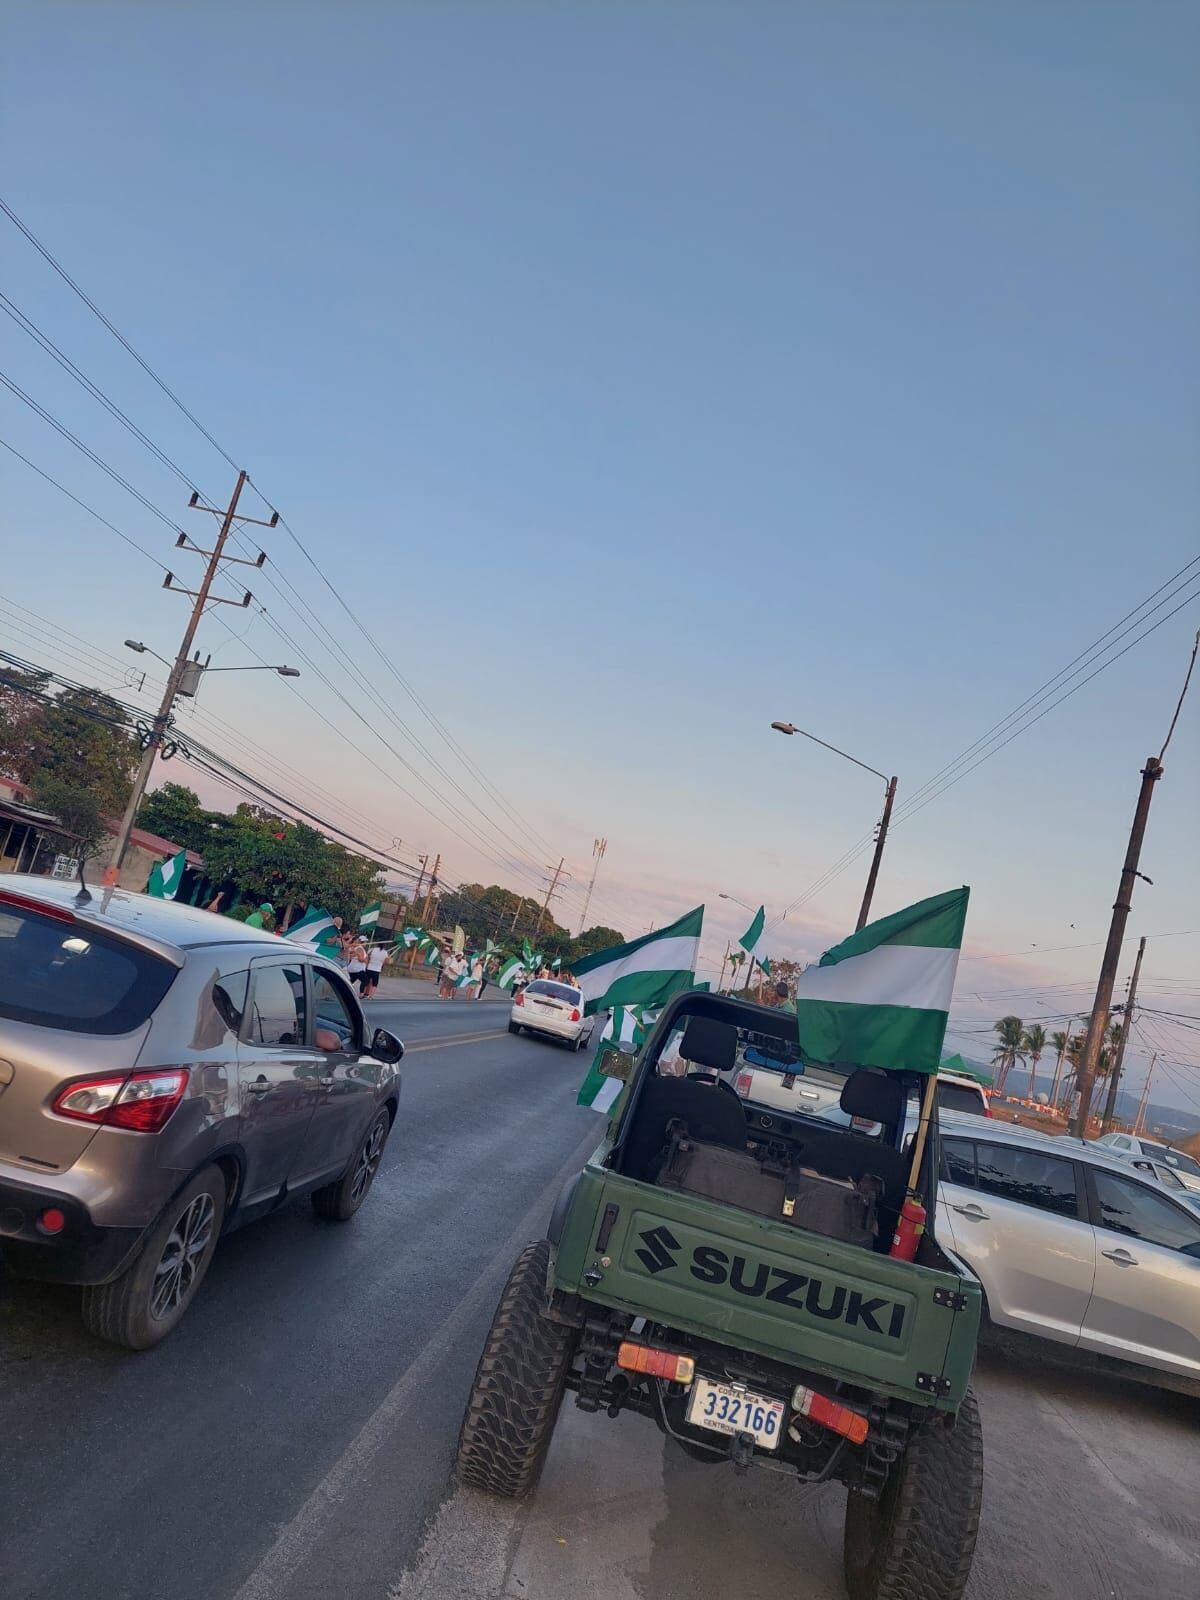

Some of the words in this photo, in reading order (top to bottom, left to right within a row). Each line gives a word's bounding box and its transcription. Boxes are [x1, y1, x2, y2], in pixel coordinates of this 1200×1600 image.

[690, 1246, 906, 1338] SUZUKI
[703, 1391, 778, 1436] 332166
[718, 1387, 741, 1399] COSTA
